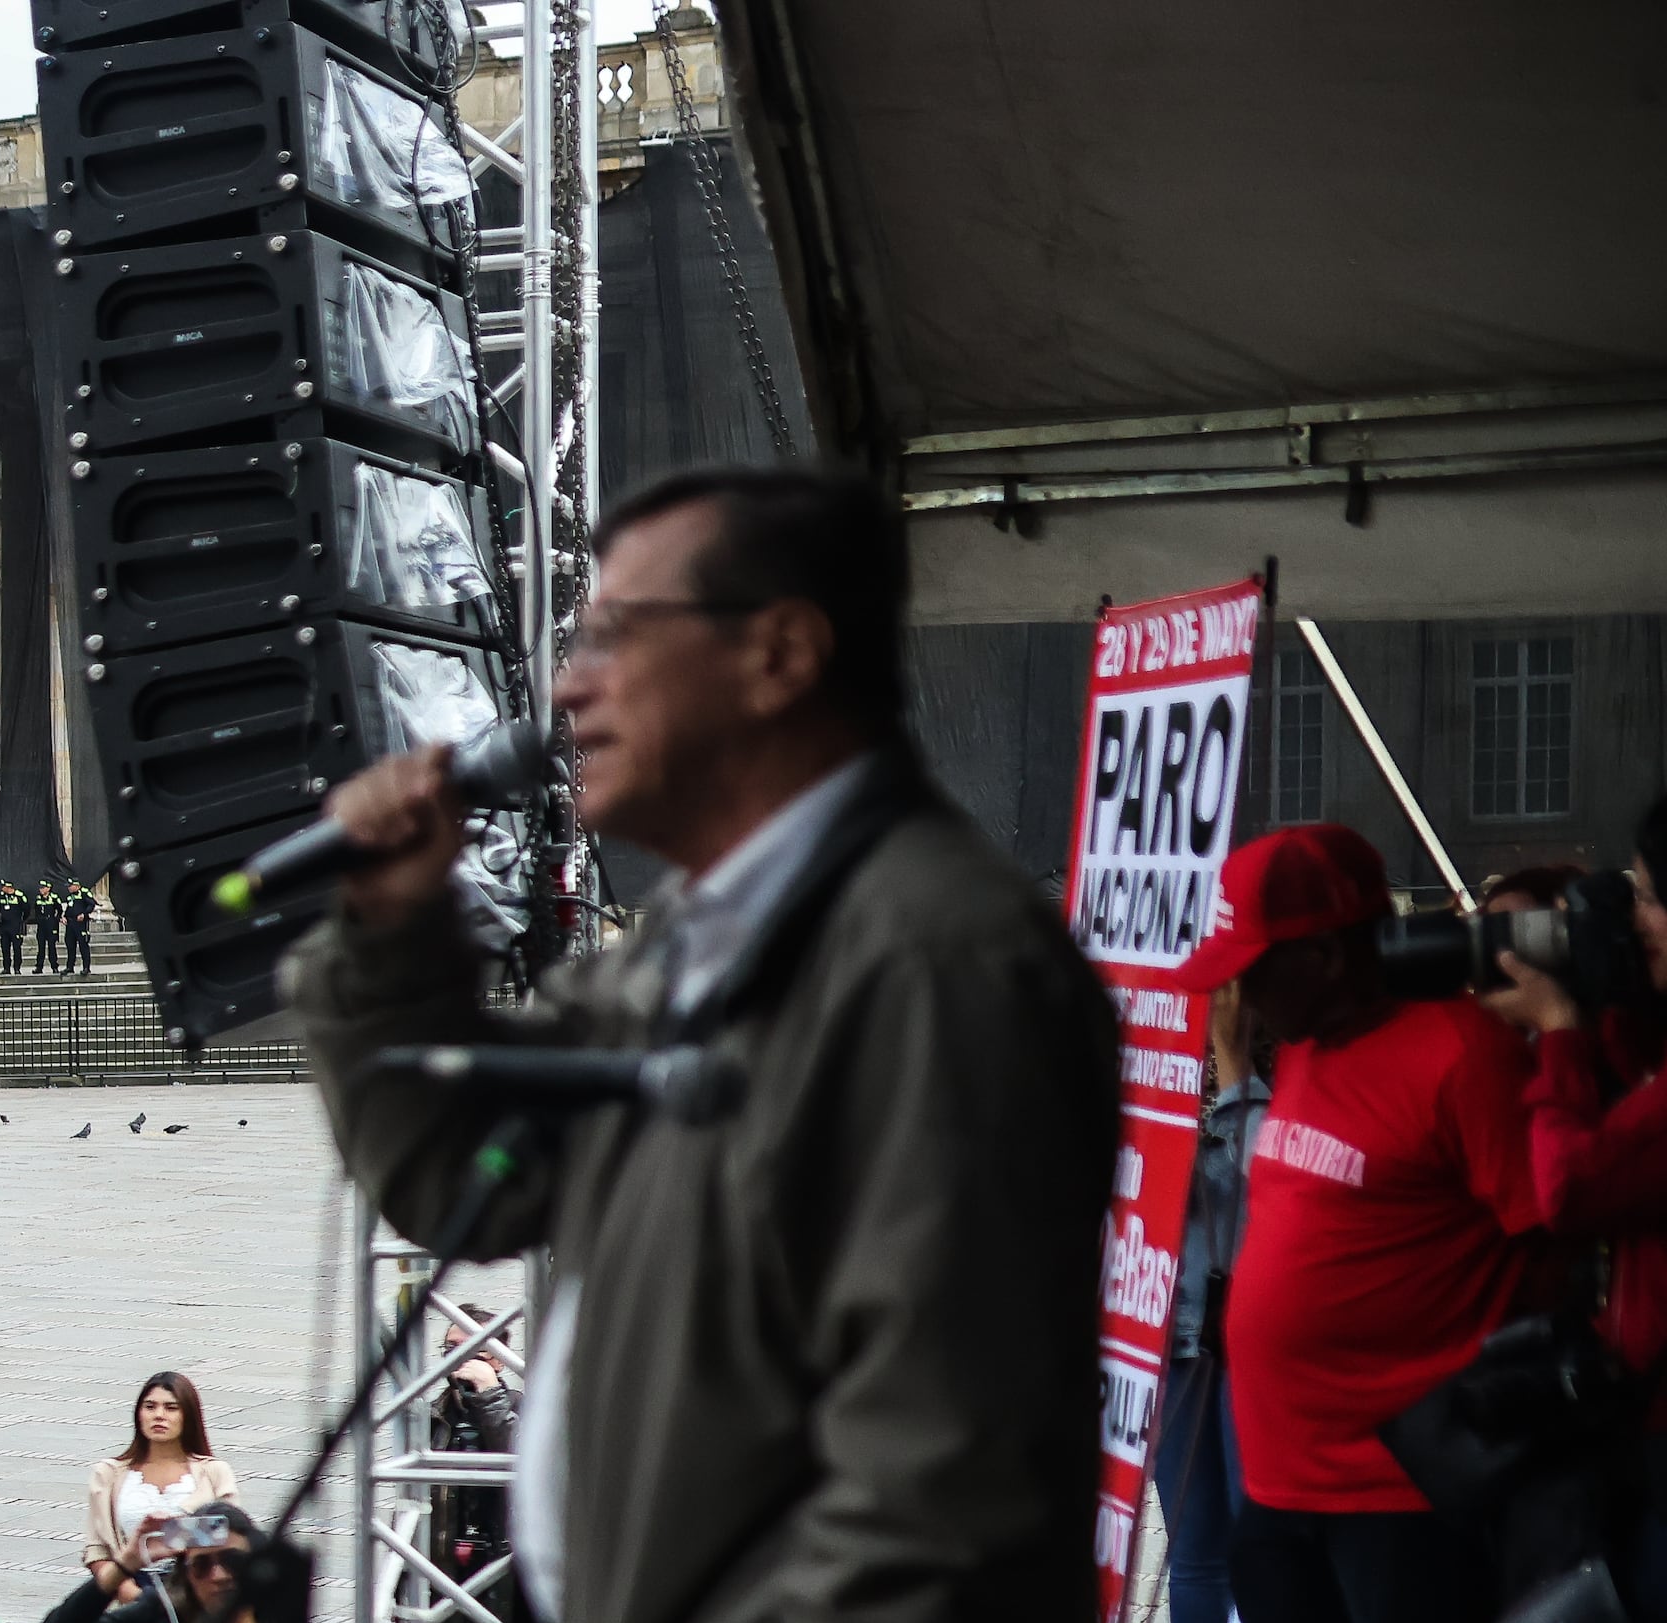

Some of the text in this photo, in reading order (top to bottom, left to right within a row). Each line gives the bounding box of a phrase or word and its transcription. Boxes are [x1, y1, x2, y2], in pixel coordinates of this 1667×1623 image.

[1097, 625, 1128, 678] 28
[1171, 610, 1199, 667] DE
[1090, 693, 1237, 858] PARO
